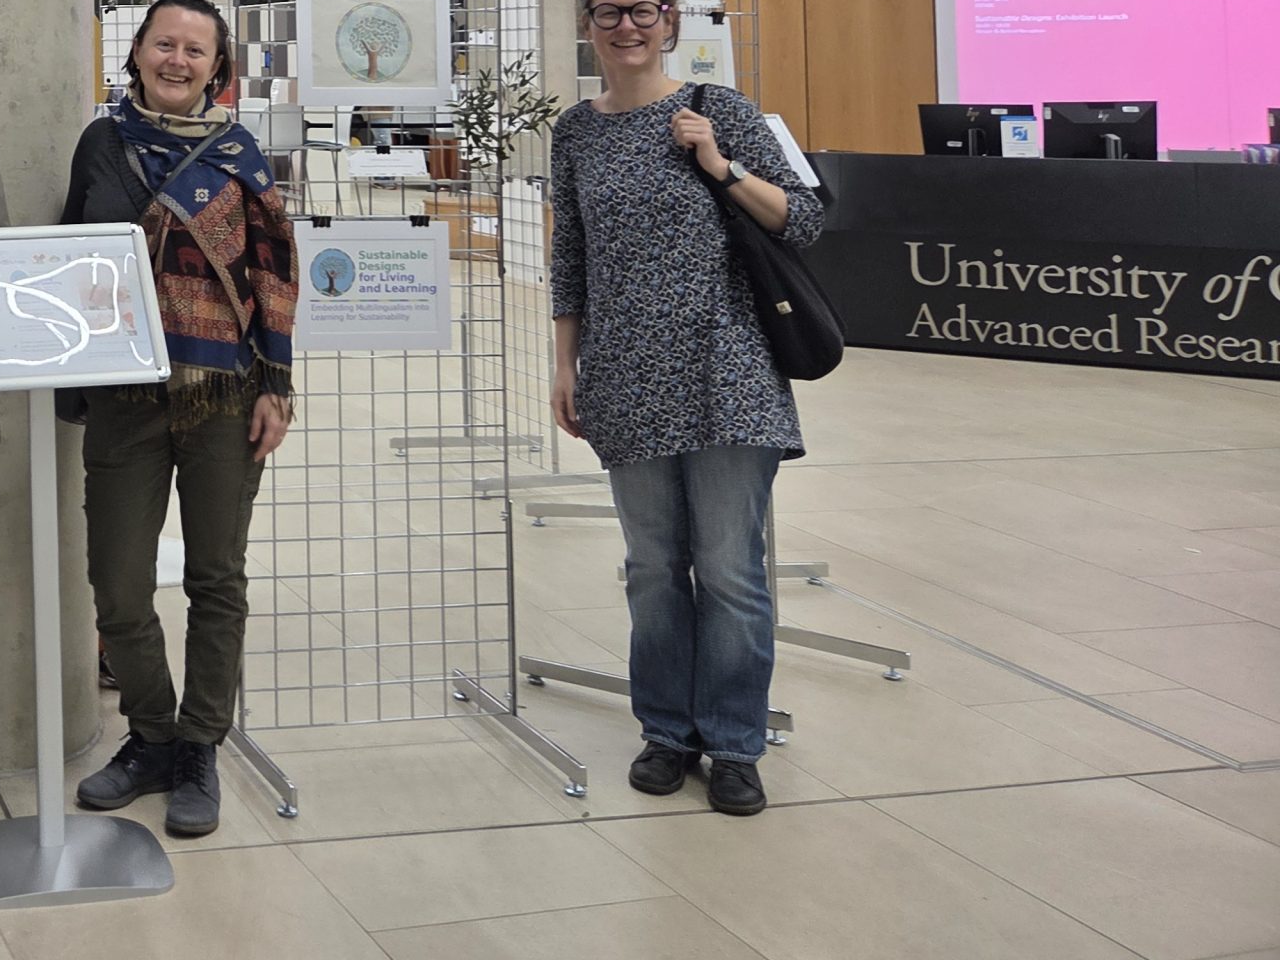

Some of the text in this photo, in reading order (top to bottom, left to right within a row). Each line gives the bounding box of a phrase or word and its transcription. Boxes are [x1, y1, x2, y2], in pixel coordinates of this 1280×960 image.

[358, 251, 429, 260] Sustainable
[358, 262, 406, 273] Designs
[358, 272, 415, 284] for Living
[904, 241, 1188, 316] University
[1202, 255, 1273, 321] of
[358, 284, 438, 295] and Learning
[311, 304, 354, 313] Embedding
[311, 313, 344, 322] Learning
[358, 313, 410, 322] Sustainability
[905, 302, 1123, 354] Advanced
